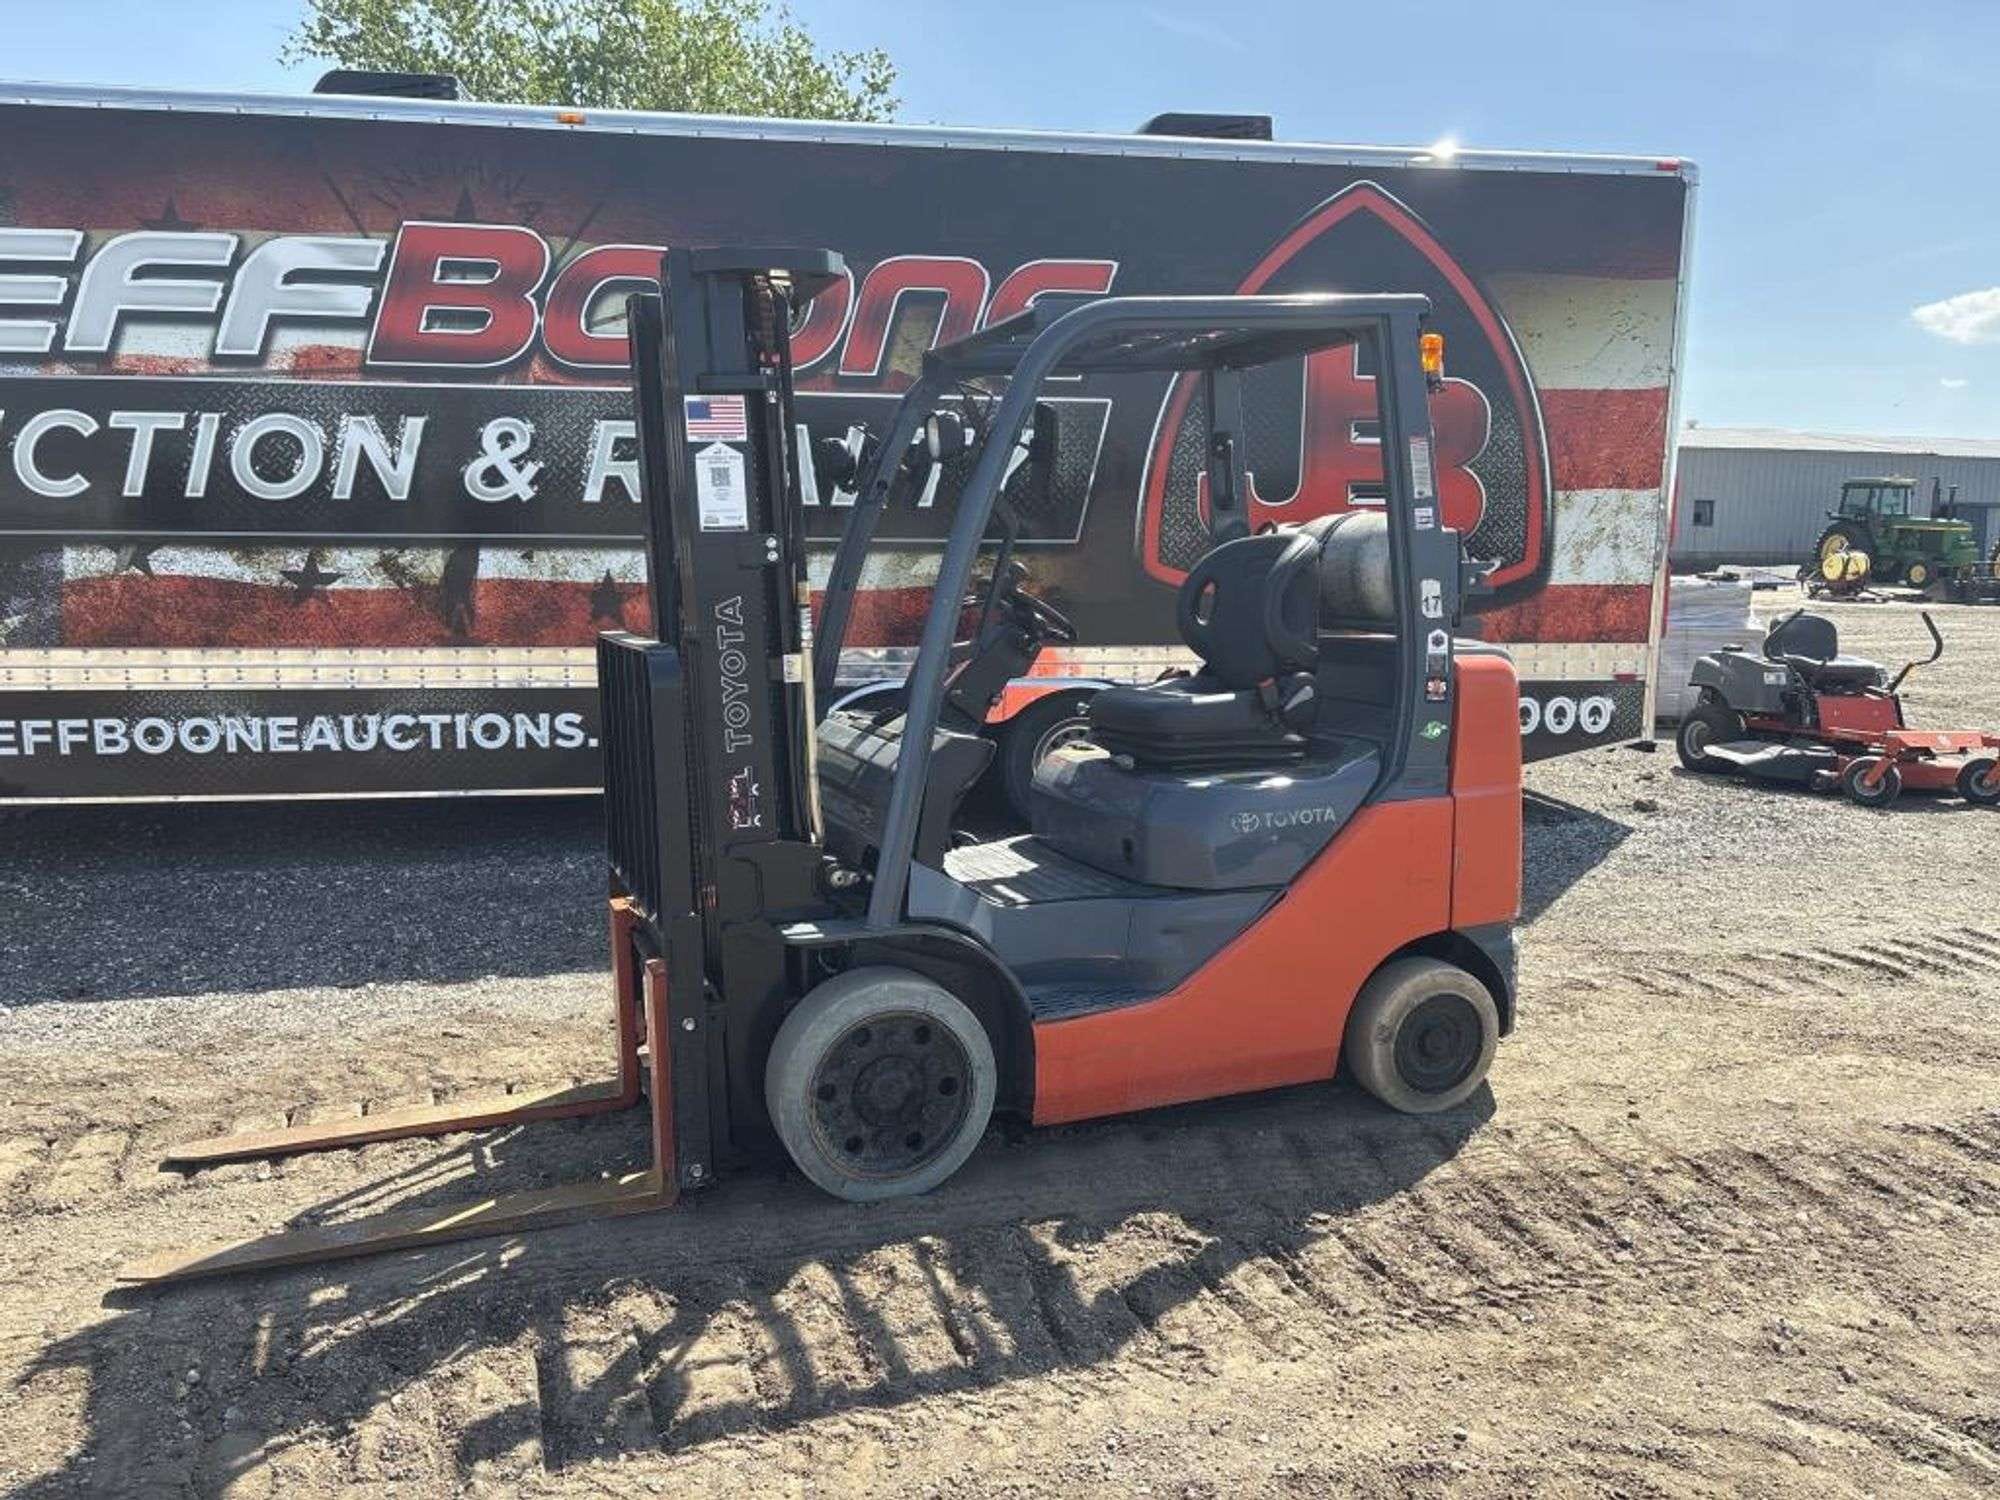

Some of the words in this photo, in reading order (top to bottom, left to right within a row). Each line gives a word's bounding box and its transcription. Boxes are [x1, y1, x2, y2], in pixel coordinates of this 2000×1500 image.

[0, 408, 427, 500] CTION
[464, 416, 545, 502] &
[715, 595, 753, 753] TOYOTA
[1265, 806, 1336, 829] TOYOTA
